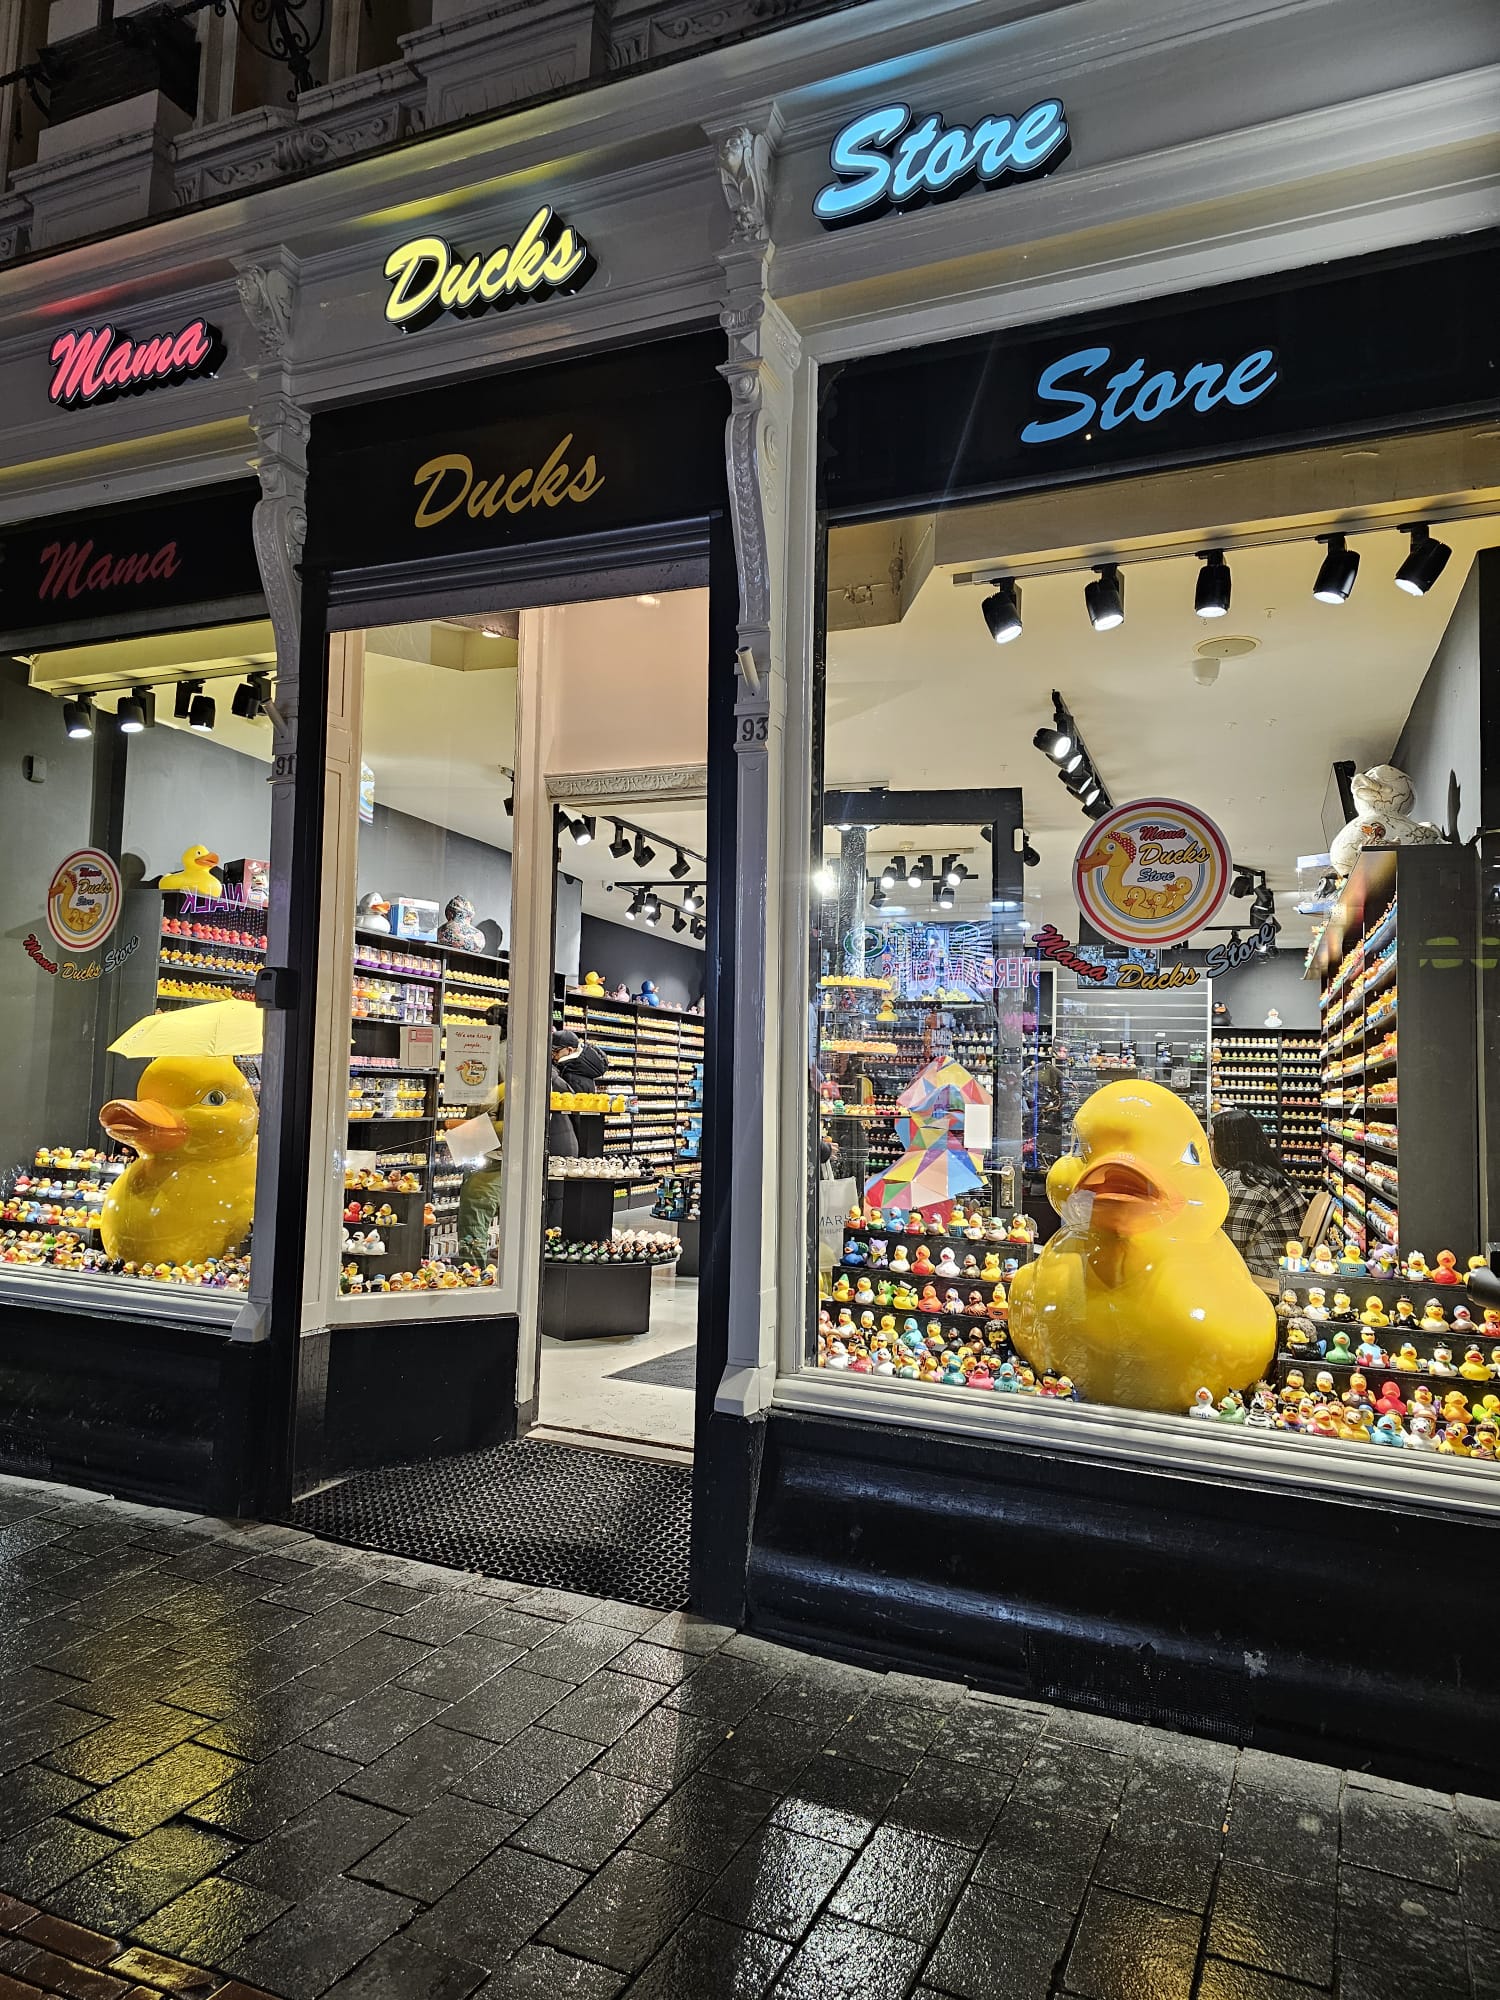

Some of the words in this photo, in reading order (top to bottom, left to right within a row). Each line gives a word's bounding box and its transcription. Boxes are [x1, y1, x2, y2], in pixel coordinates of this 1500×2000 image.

[816, 99, 1067, 215] Store
[384, 204, 584, 322] Ducks
[50, 320, 213, 402] Mama
[1020, 346, 1278, 445] Store
[413, 432, 605, 530] Ducks
[38, 539, 184, 600] Mama
[742, 717, 768, 742] 93
[276, 754, 297, 775] 91
[1138, 825, 1188, 842] Mama
[1138, 841, 1211, 866] Ducks
[78, 878, 112, 895] Ducks
[1136, 868, 1176, 883] Store
[23, 933, 59, 975] Mama
[61, 961, 102, 981] Ducks
[104, 935, 140, 973] Store
[1033, 924, 1111, 982] Mama
[1116, 962, 1201, 990] Ducks
[1206, 923, 1276, 978] Store
